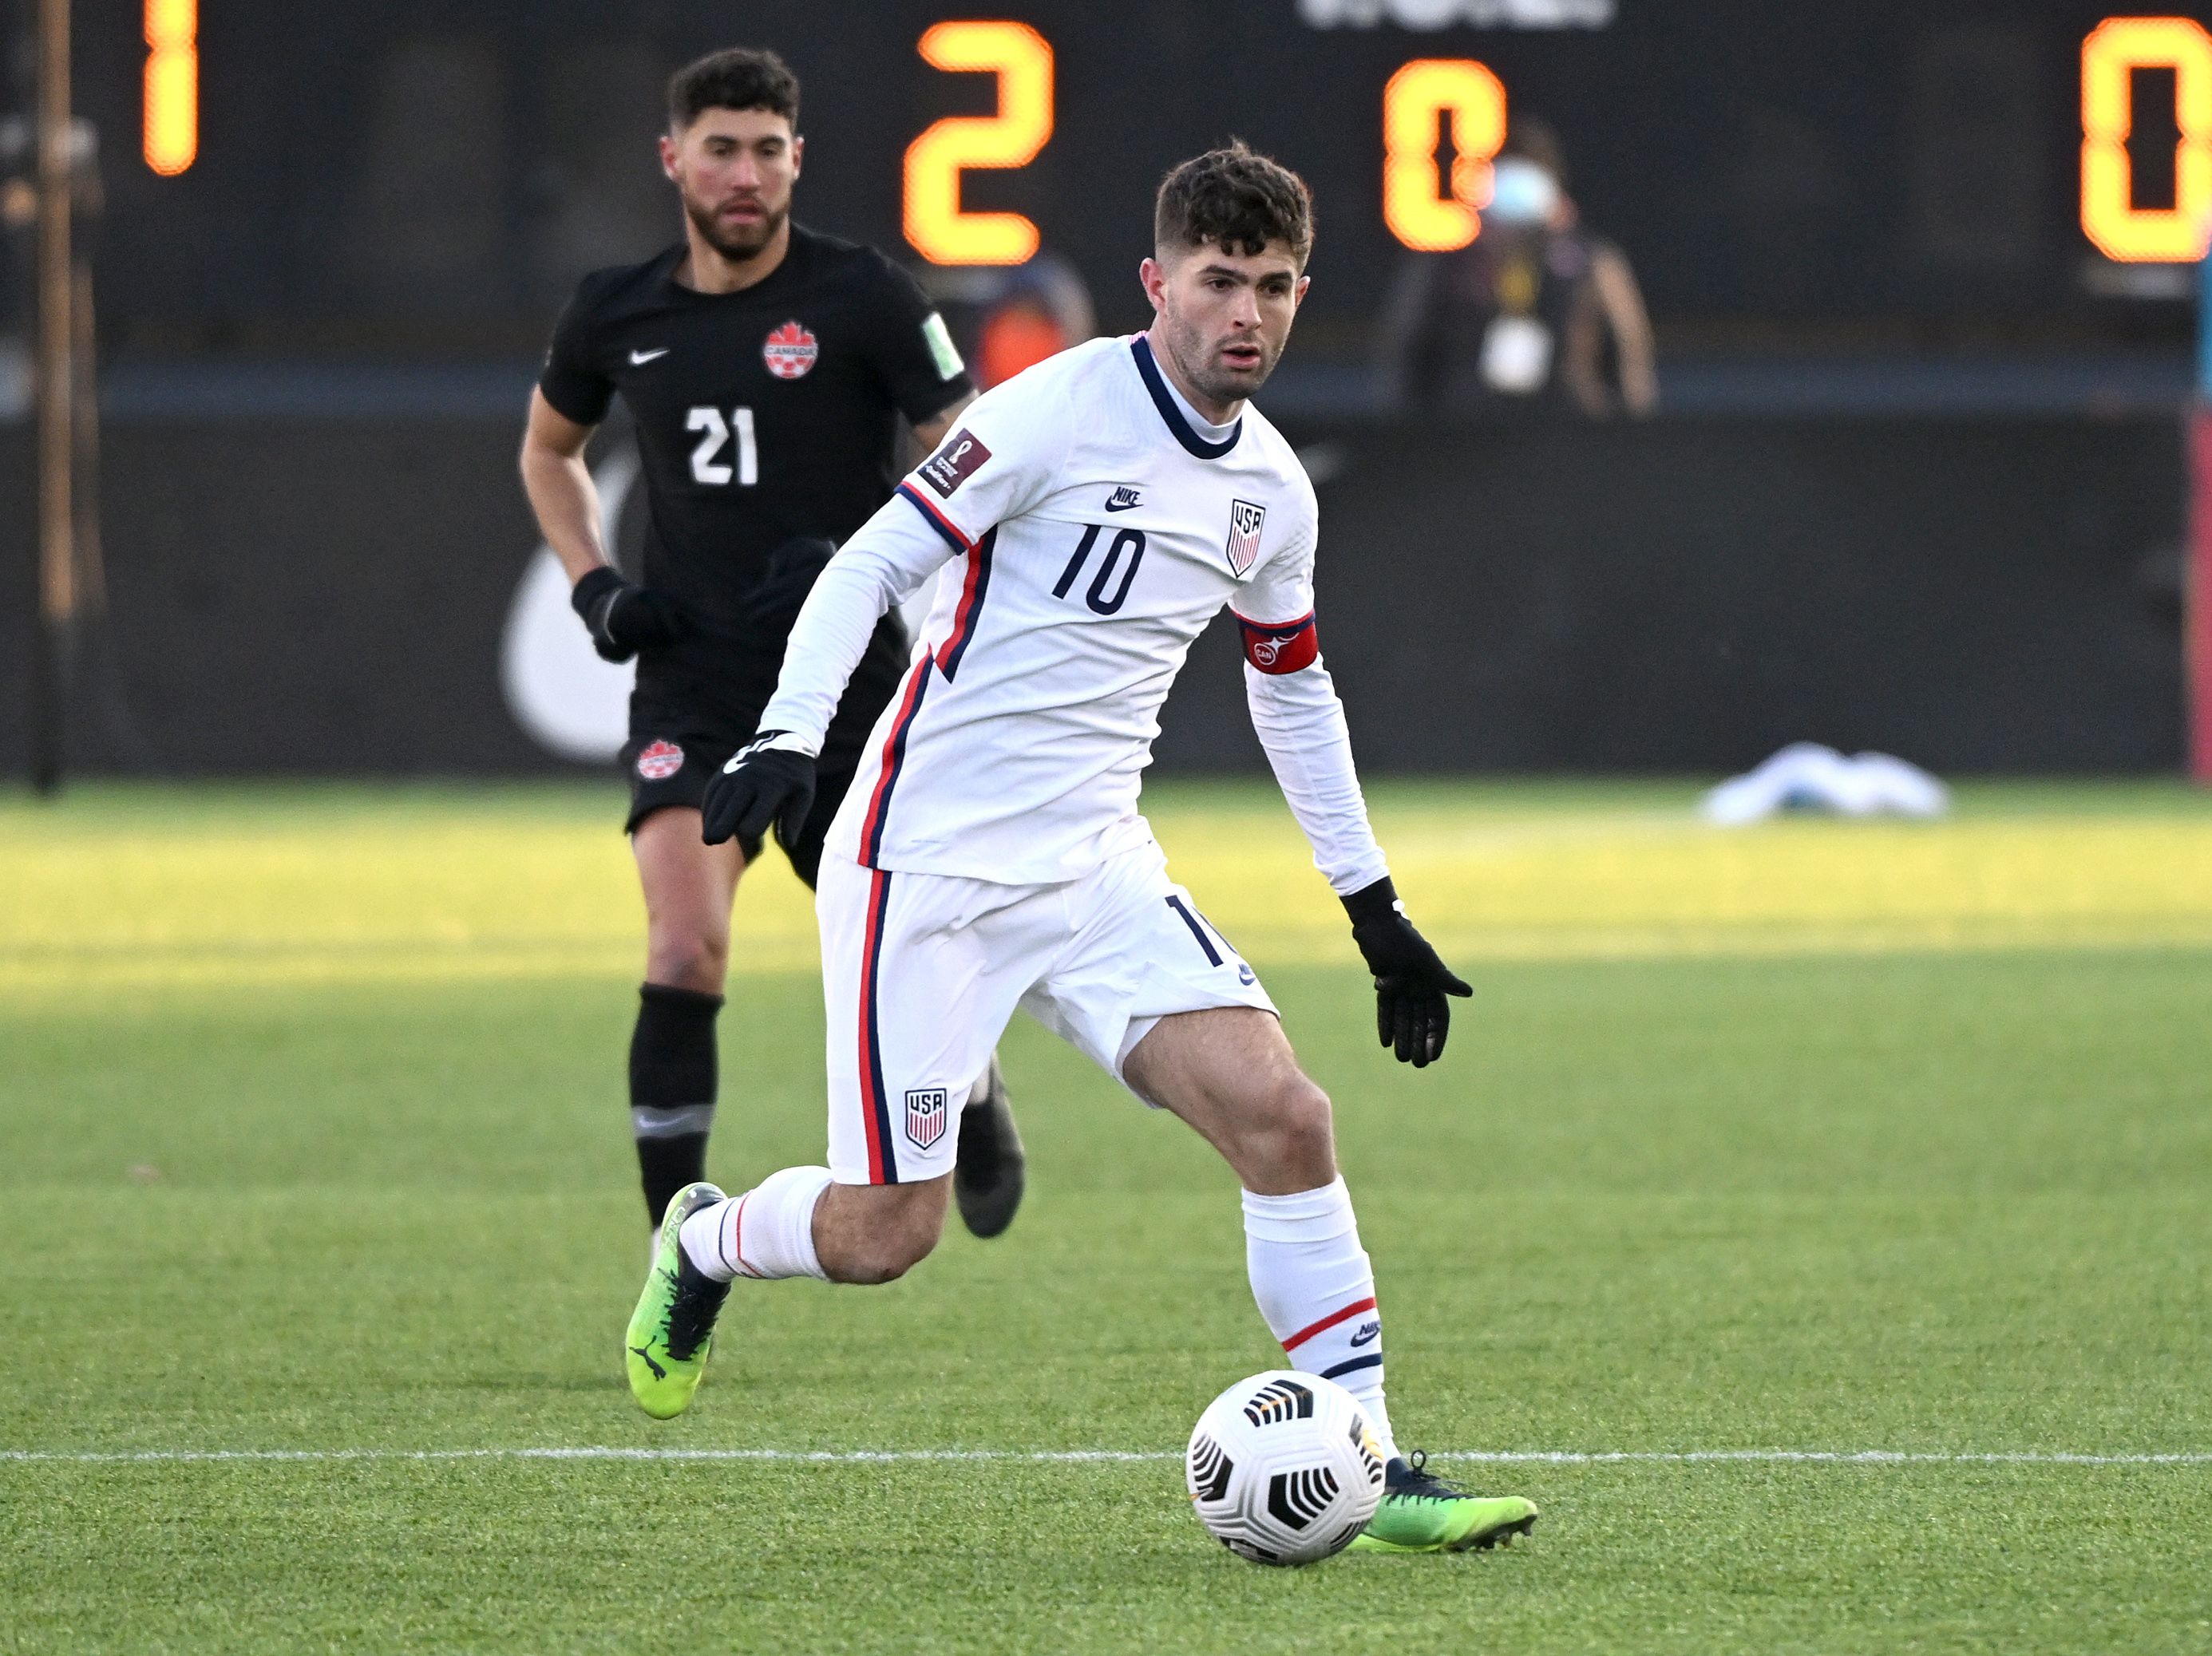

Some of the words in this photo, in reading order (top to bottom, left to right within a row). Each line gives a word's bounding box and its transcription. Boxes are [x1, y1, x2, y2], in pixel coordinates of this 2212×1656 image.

[903, 21, 1055, 265] 2
[1383, 58, 1507, 252] 0
[2080, 16, 2212, 262] 0
[685, 406, 758, 485] 21
[1112, 486, 1141, 506] NIKE
[1235, 504, 1262, 534] USA
[1051, 523, 1146, 615] 10
[1165, 895, 1238, 968] 1
[910, 1093, 943, 1115] USA
